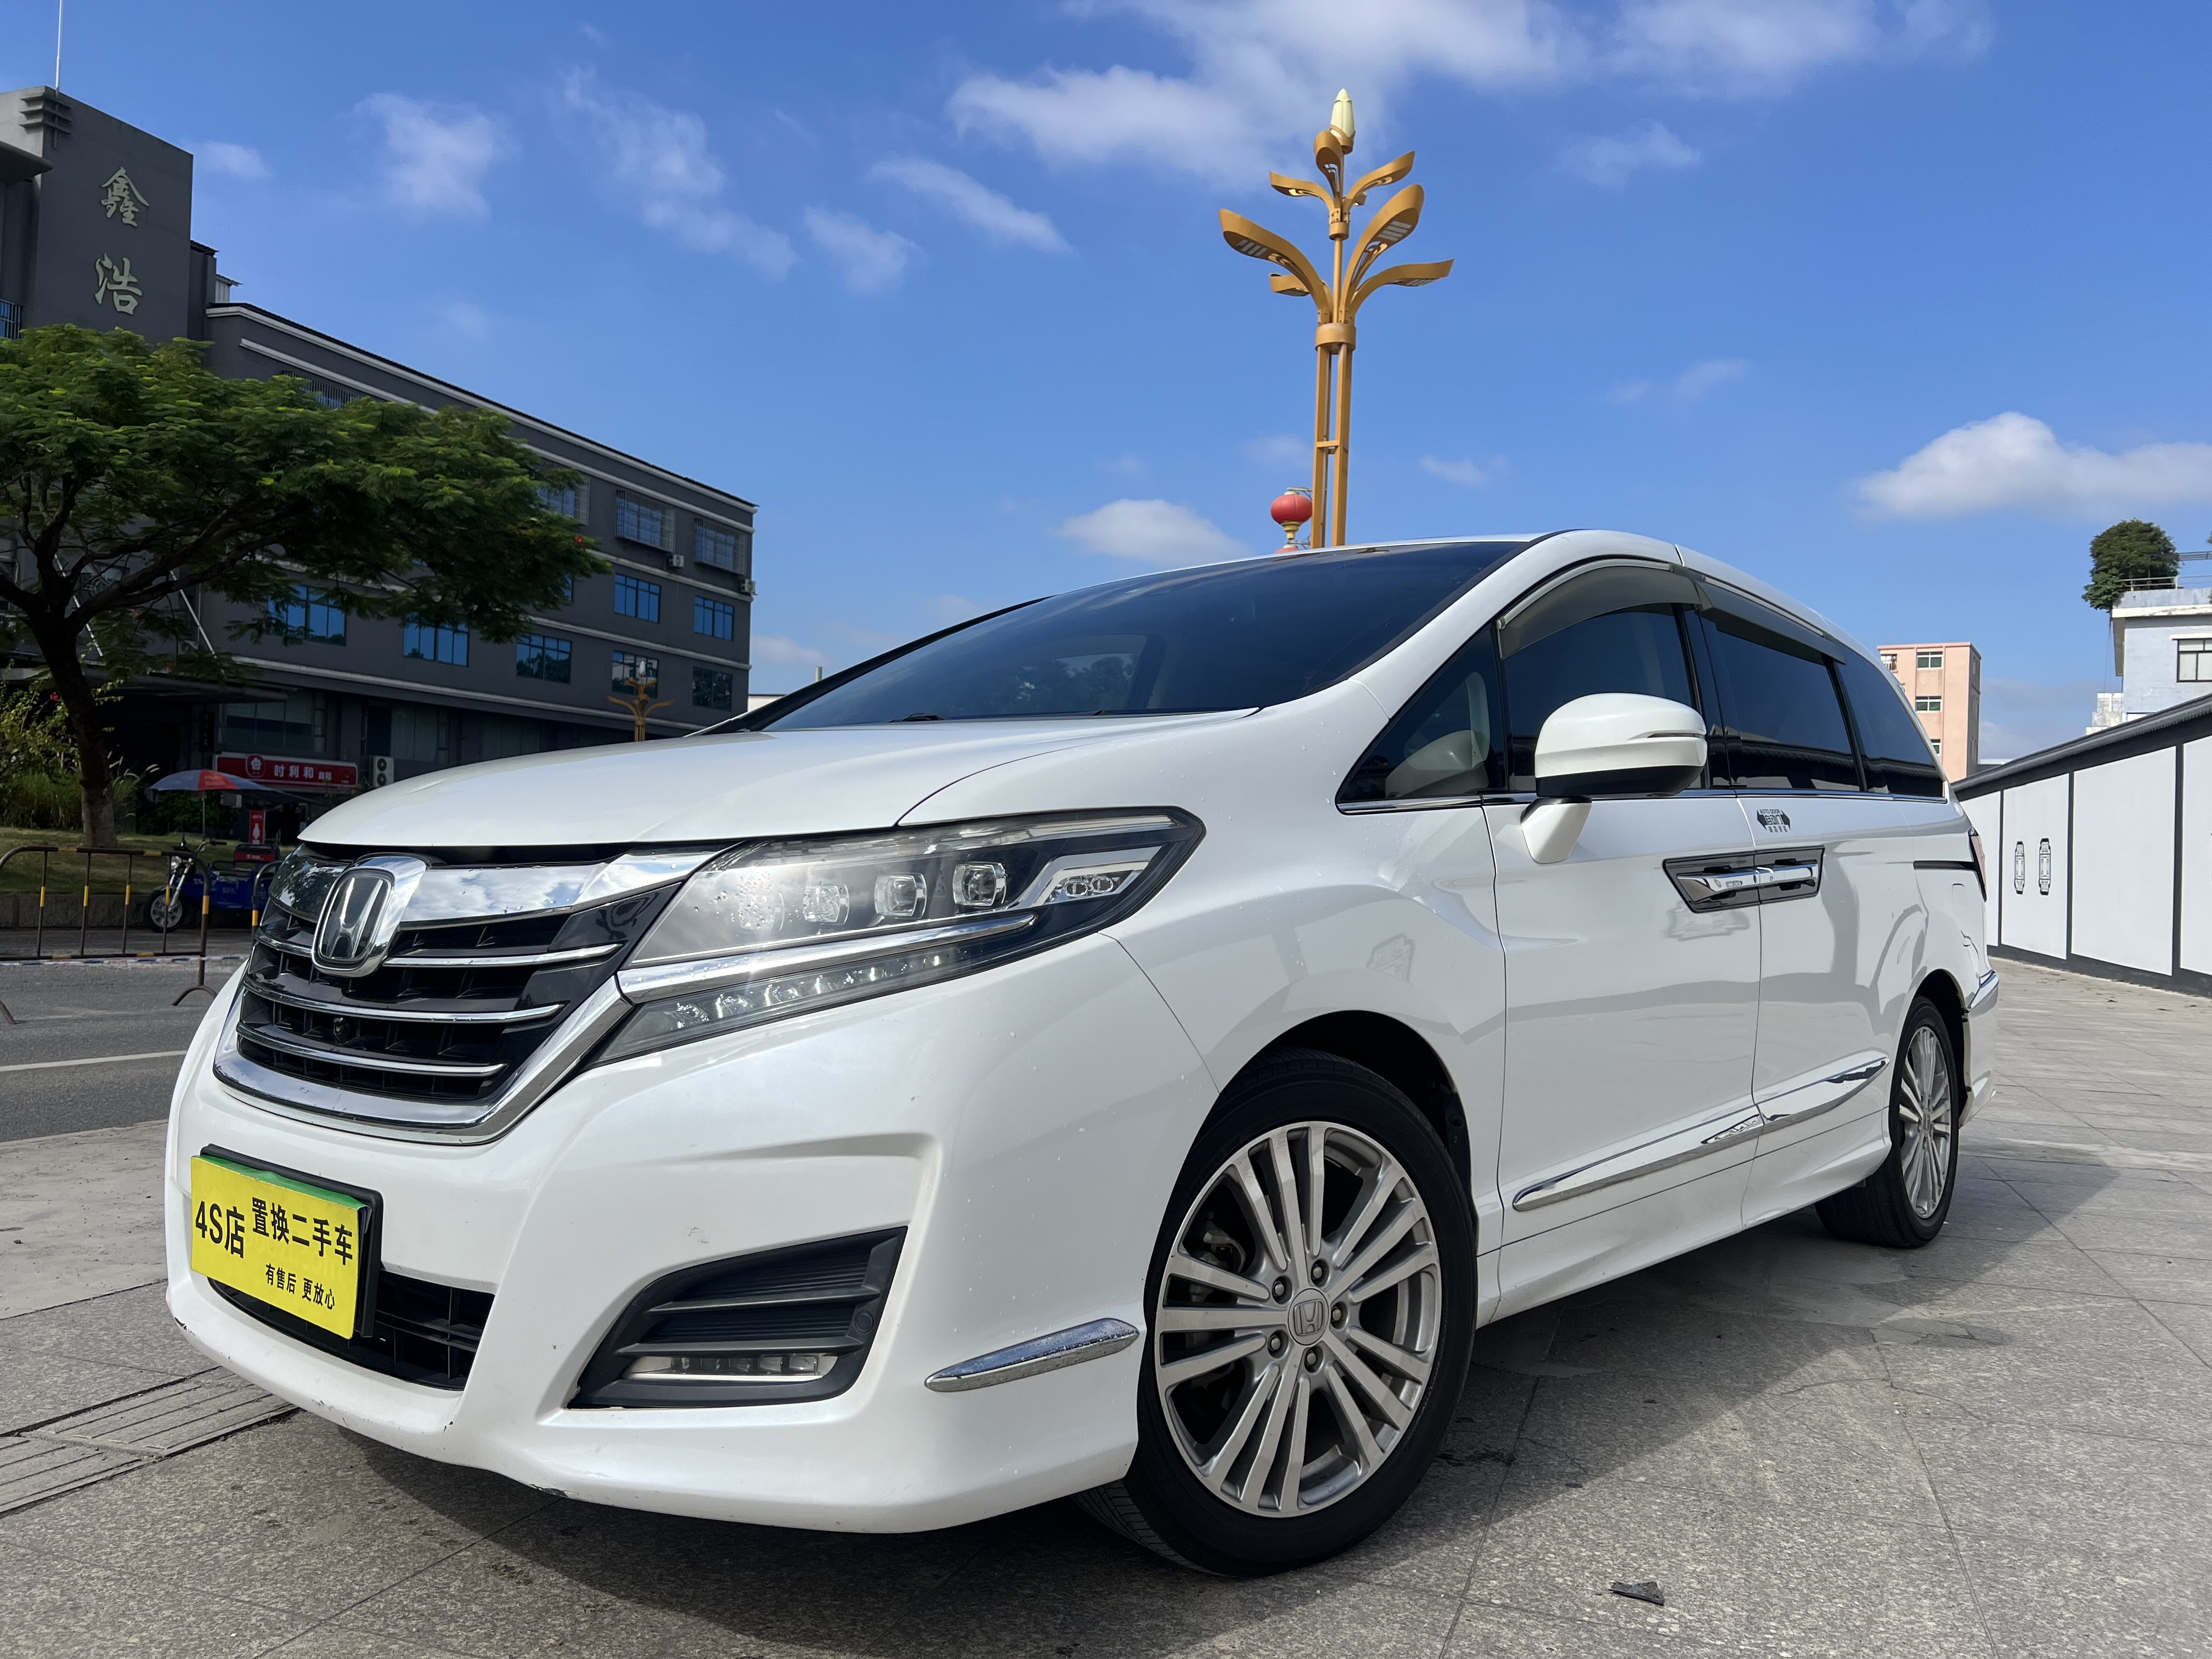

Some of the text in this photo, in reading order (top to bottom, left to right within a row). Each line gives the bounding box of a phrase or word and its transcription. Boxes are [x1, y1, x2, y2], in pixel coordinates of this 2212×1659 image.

[94, 166, 150, 315] 鑫浩
[274, 764, 314, 779] 时利和
[195, 1197, 353, 1266] 4S店 置换二手车
[265, 1263, 335, 1310] 有售后 更放心
